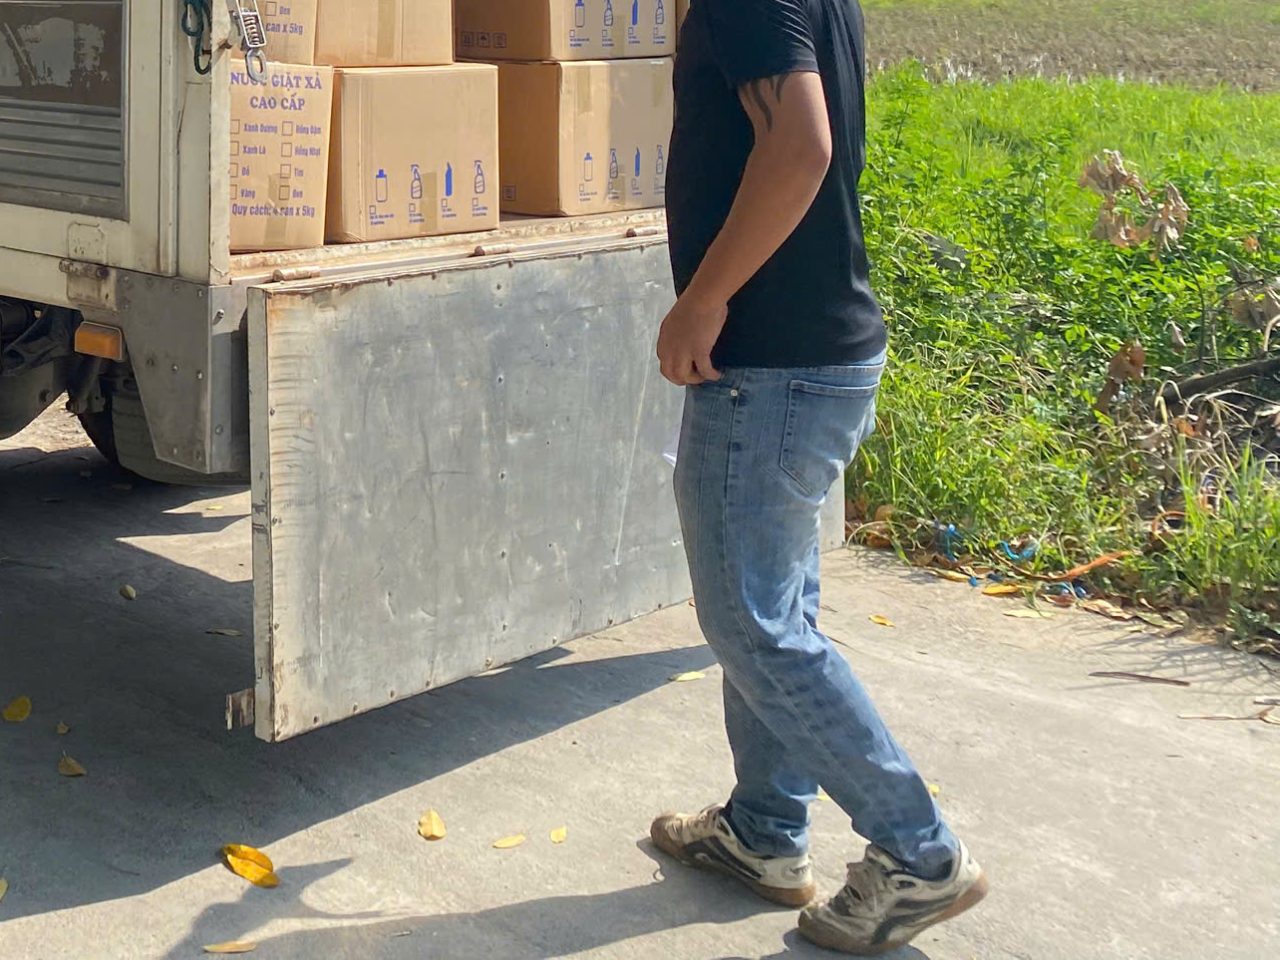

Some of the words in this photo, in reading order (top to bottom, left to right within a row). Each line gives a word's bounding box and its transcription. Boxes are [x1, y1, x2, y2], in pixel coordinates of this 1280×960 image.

[265, 23, 280, 33] can
[289, 23, 303, 35] 5kg
[272, 71, 301, 91] GIẶT
[305, 71, 322, 89] XẢ
[250, 96, 277, 110] CAO
[281, 92, 305, 110] CẤP
[232, 204, 248, 216] Quy
[302, 205, 315, 218] 5kg
